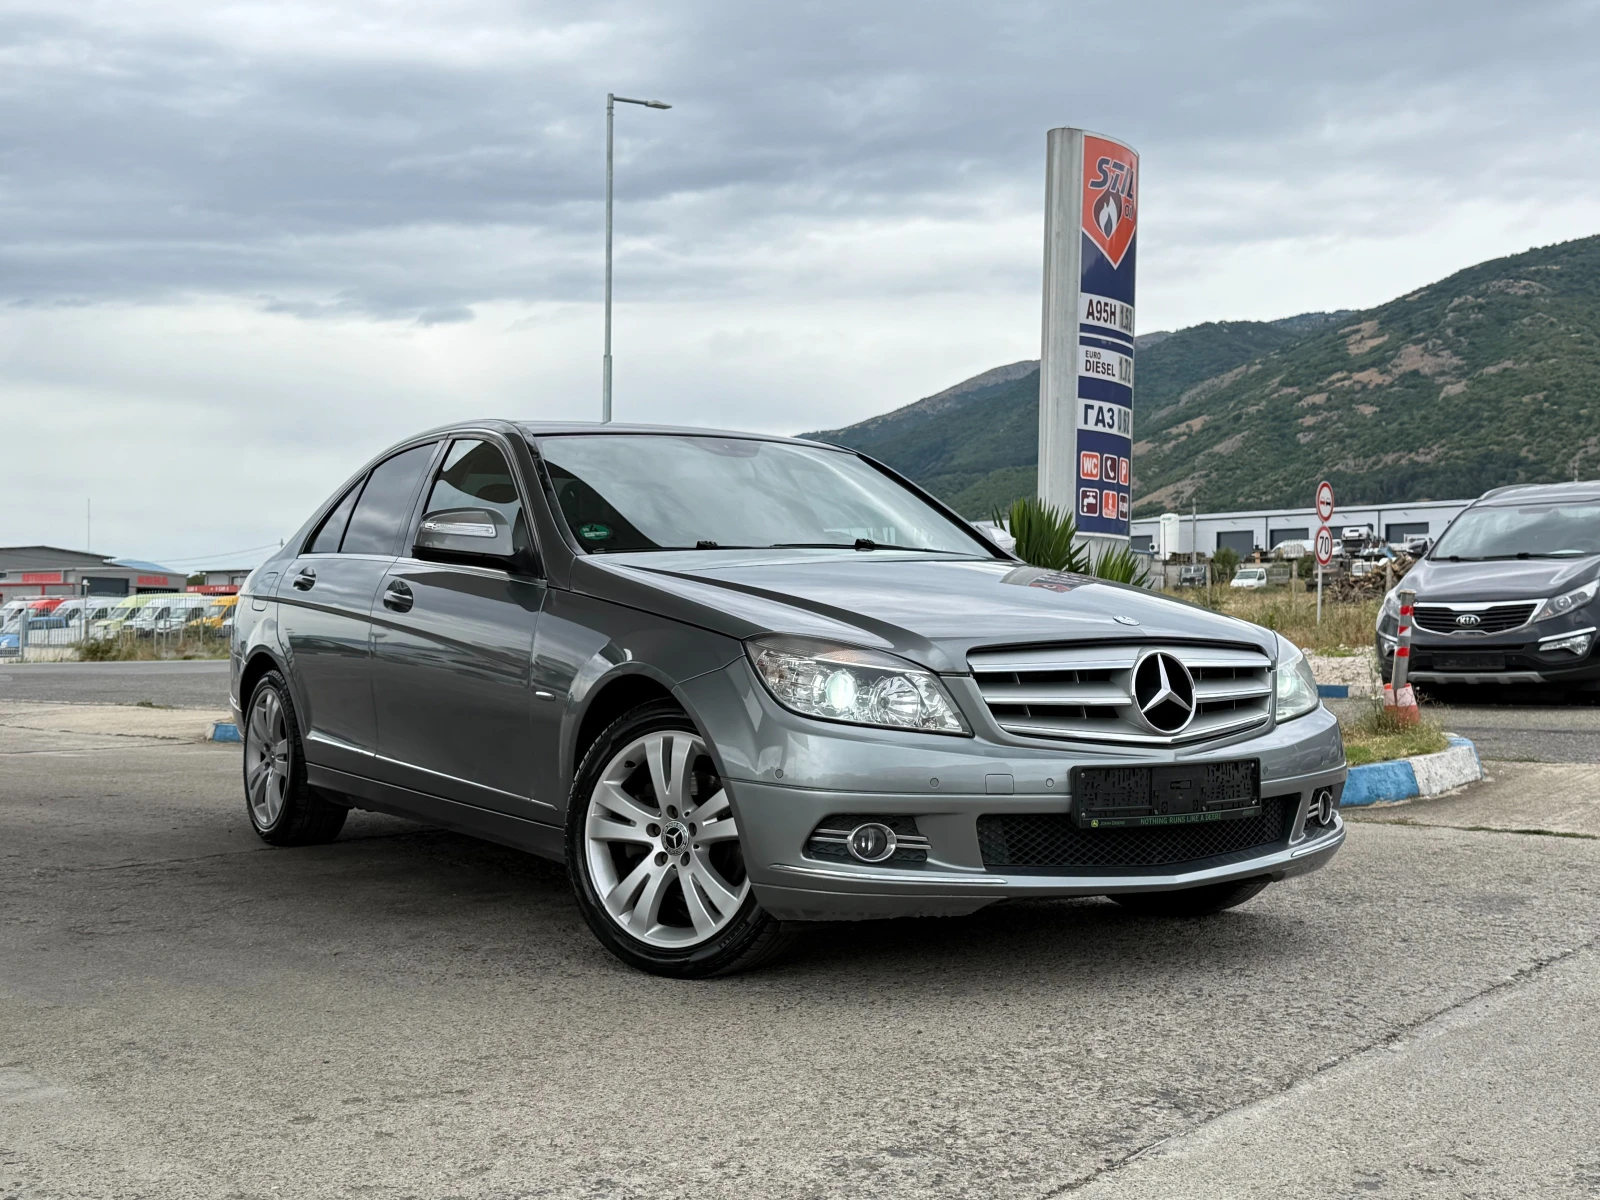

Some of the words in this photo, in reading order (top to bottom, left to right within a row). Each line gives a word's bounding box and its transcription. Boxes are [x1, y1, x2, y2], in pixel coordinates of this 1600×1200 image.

[1089, 157, 1134, 200] STIL
[1086, 298, 1116, 325] A95H
[1085, 350, 1101, 360] EURO
[1085, 359, 1116, 377] DIESEL
[1084, 404, 1115, 429] ГАЗ
[1083, 456, 1098, 475] WC
[1121, 461, 1127, 482] P
[1320, 536, 1329, 554] 70
[1460, 616, 1475, 624] KIA
[1140, 816, 1168, 825] NOTHING
[1169, 815, 1186, 824] RUNS
[1186, 814, 1200, 823] LIKE
[1206, 813, 1222, 821] DEERE
